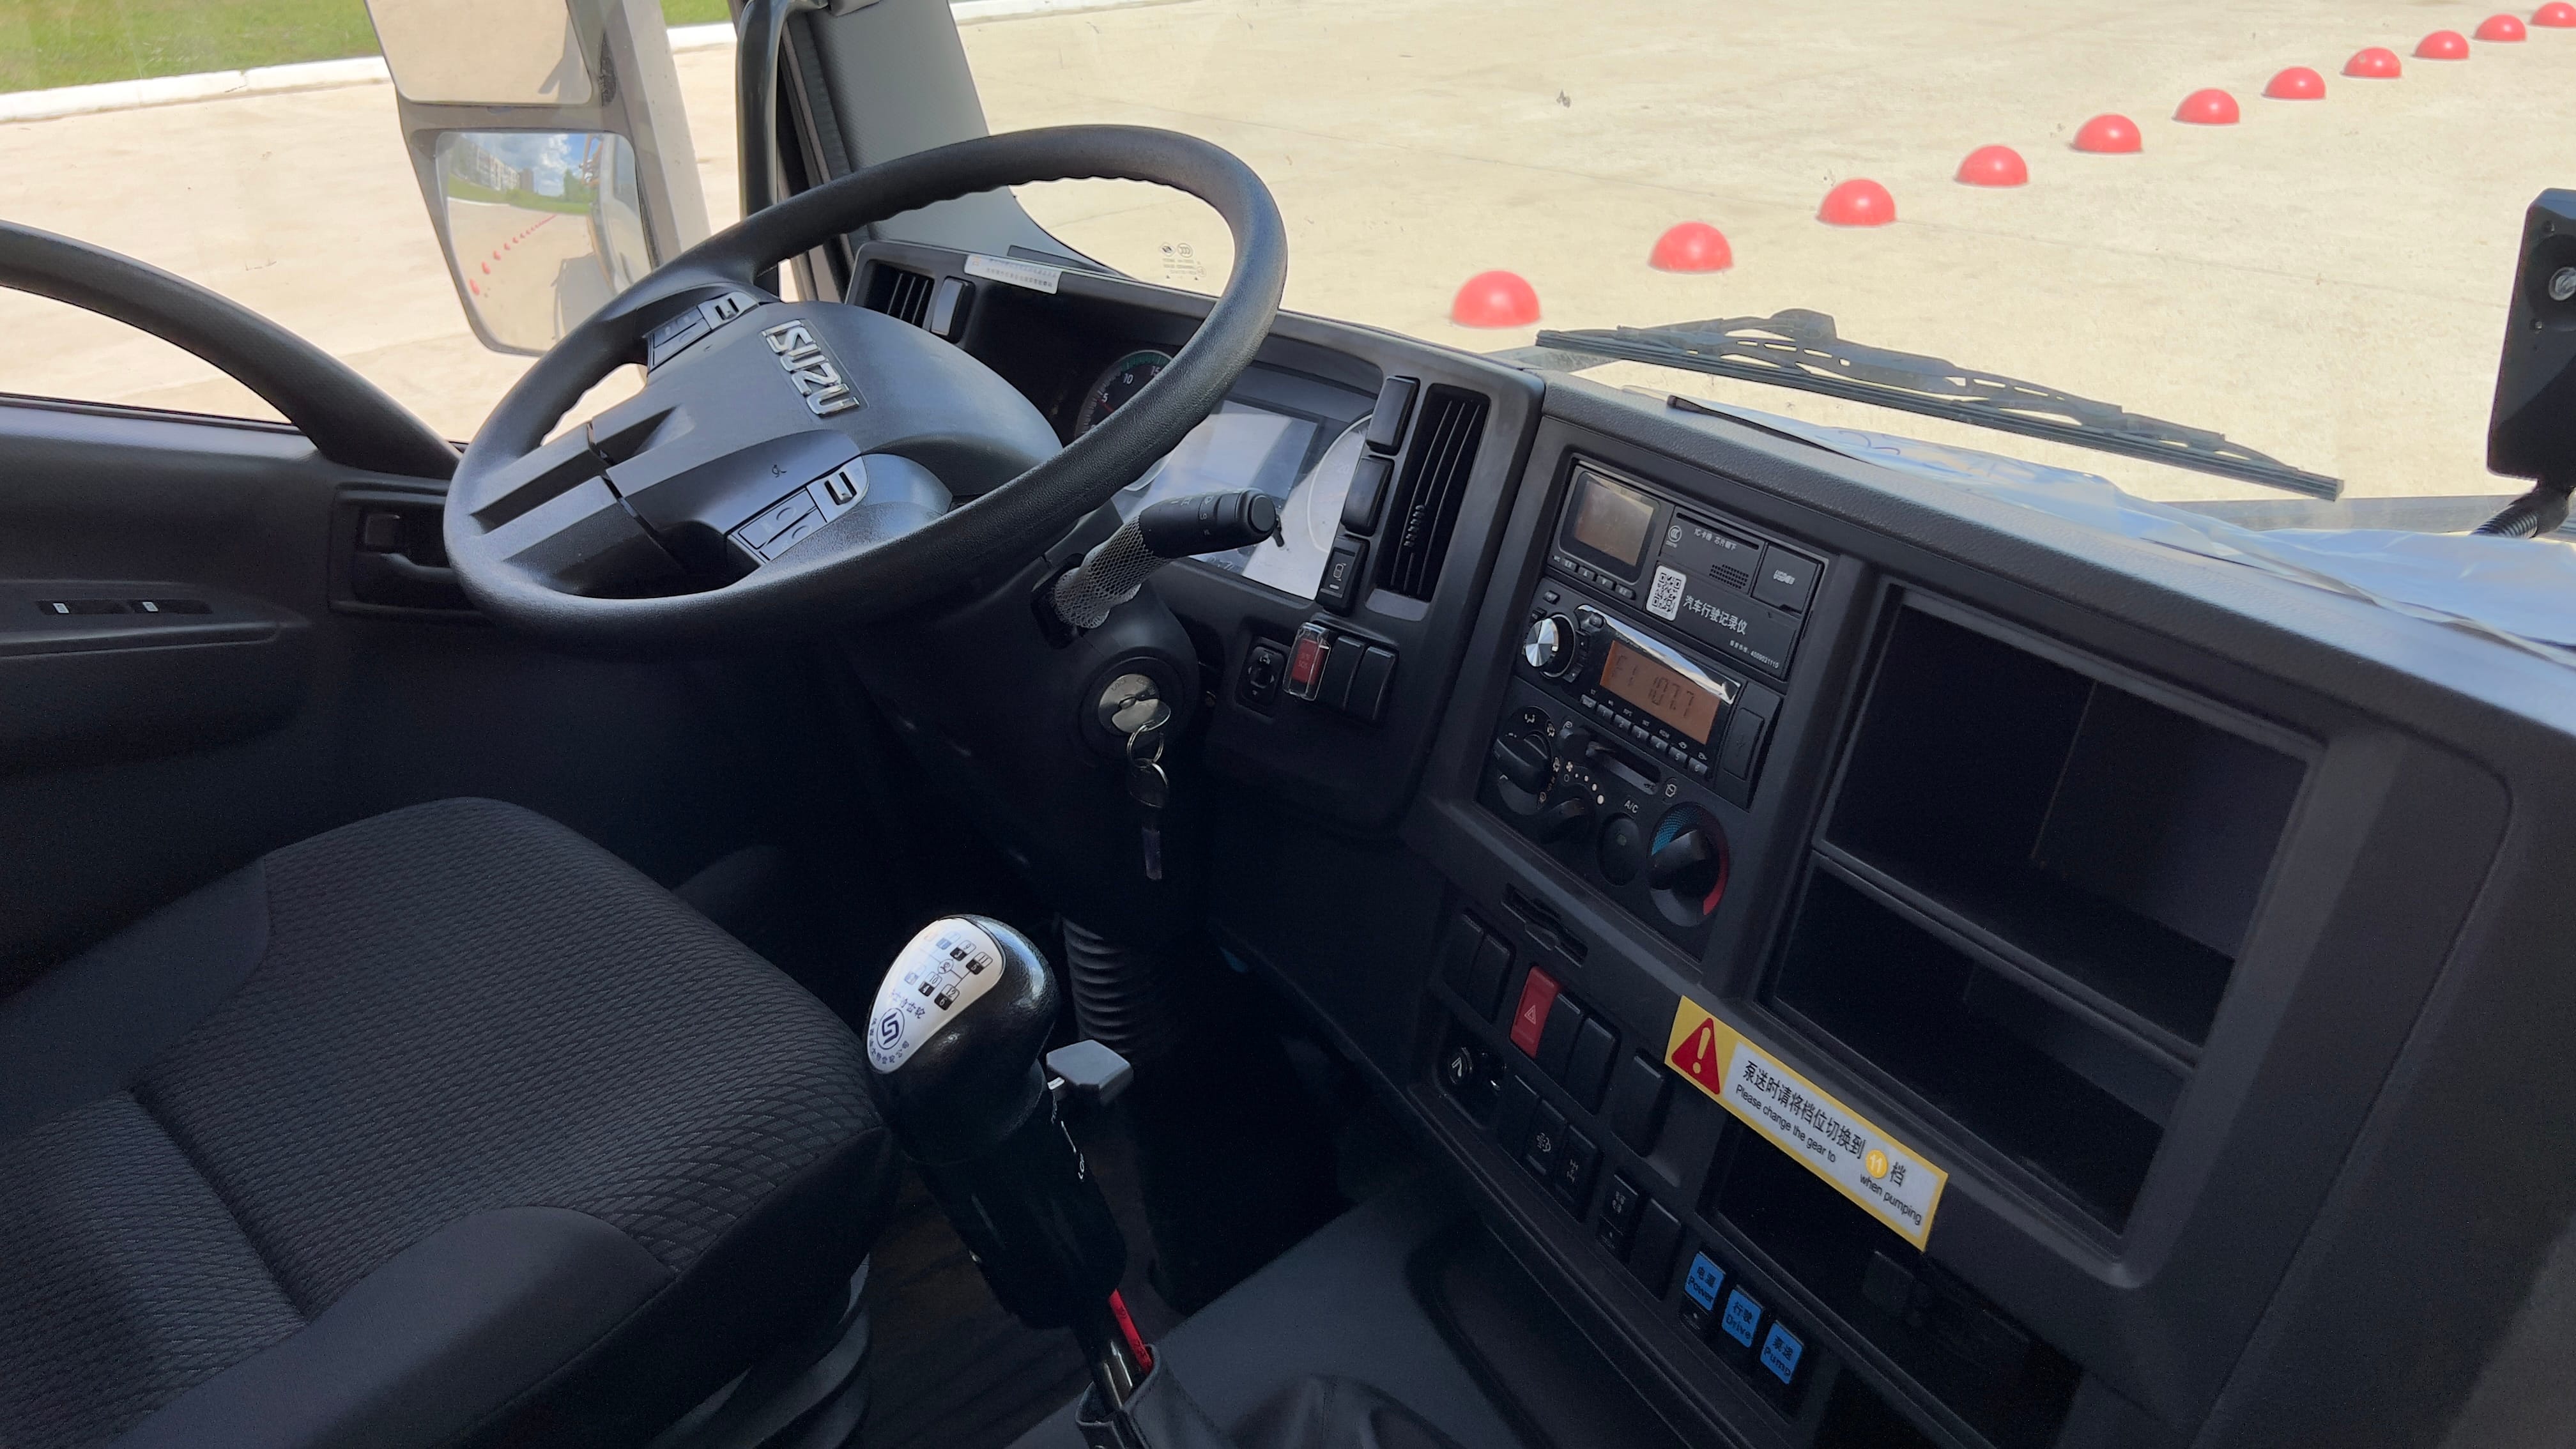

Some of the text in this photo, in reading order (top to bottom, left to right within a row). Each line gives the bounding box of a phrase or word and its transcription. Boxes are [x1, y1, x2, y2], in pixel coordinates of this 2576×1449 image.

[761, 319, 859, 417] ISUZU
[1123, 373, 1133, 384] 10
[1101, 393, 1108, 402] 5
[1683, 595, 1748, 635] 汽车行驶记录仪
[1624, 799, 1639, 814] A/C
[930, 976, 939, 985] 10
[946, 987, 956, 997] 12
[1743, 1061, 1906, 1187] 泵送时请将档位切换到 11 档
[1735, 1084, 1922, 1225] Please change the gear to when pumping
[1696, 1265, 1716, 1289] 电源
[1687, 1276, 1713, 1304] Power
[1732, 1300, 1754, 1324] 行驶
[1726, 1314, 1752, 1340] Drive
